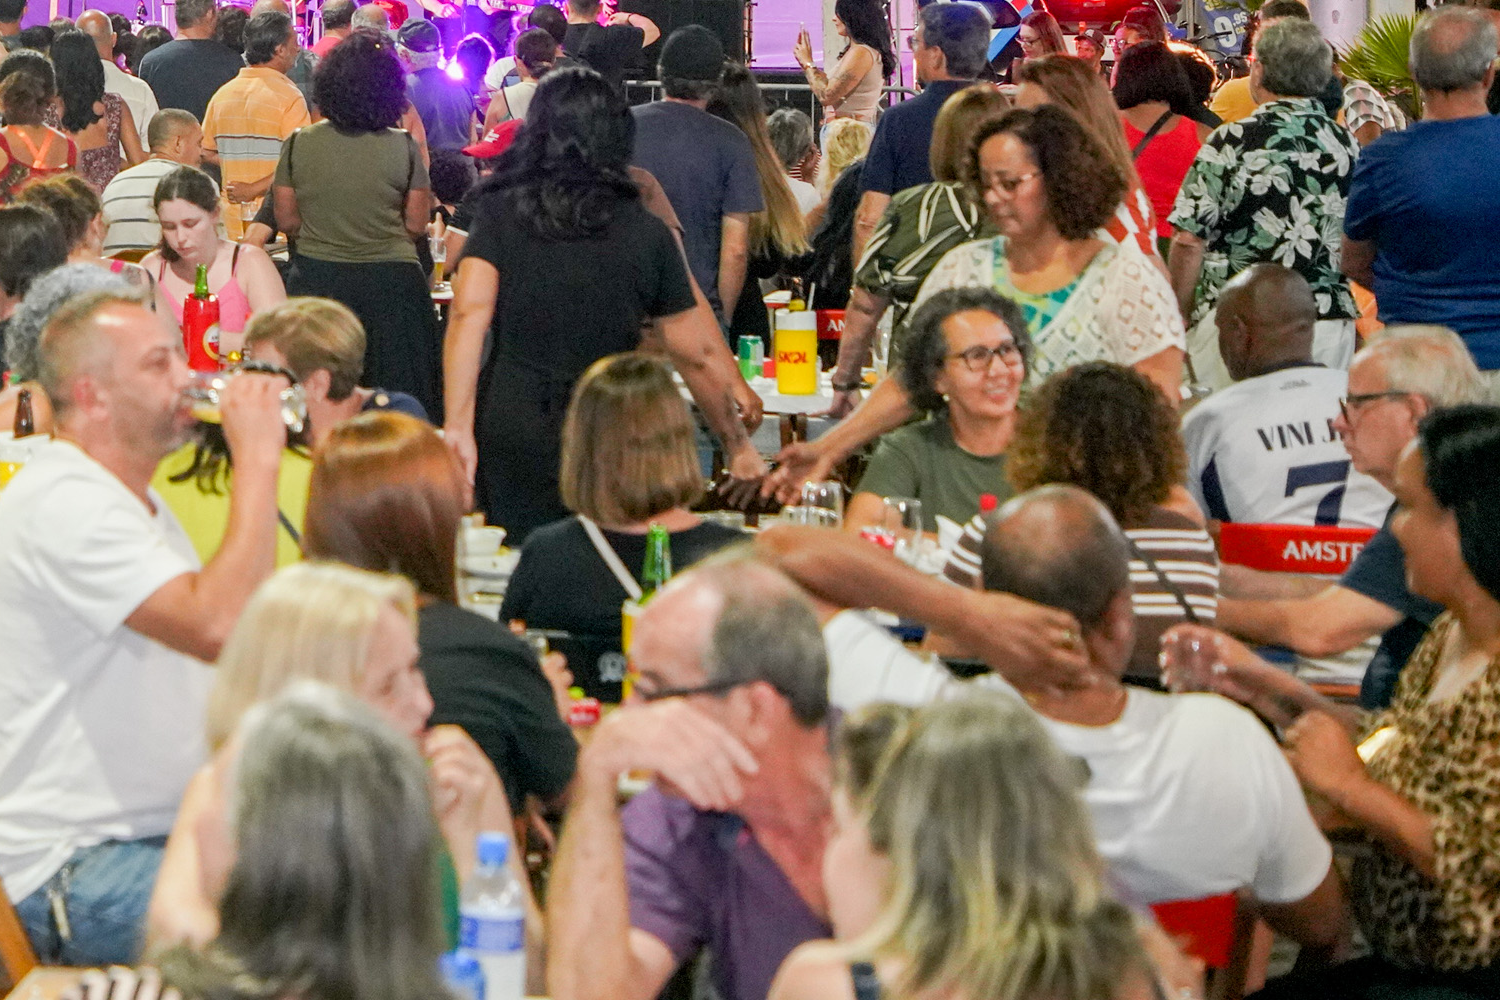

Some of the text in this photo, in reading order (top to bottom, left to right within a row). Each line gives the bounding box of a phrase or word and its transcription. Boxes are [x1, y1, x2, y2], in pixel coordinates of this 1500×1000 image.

[1256, 418, 1344, 450] VINI J
[1284, 459, 1352, 527] 7
